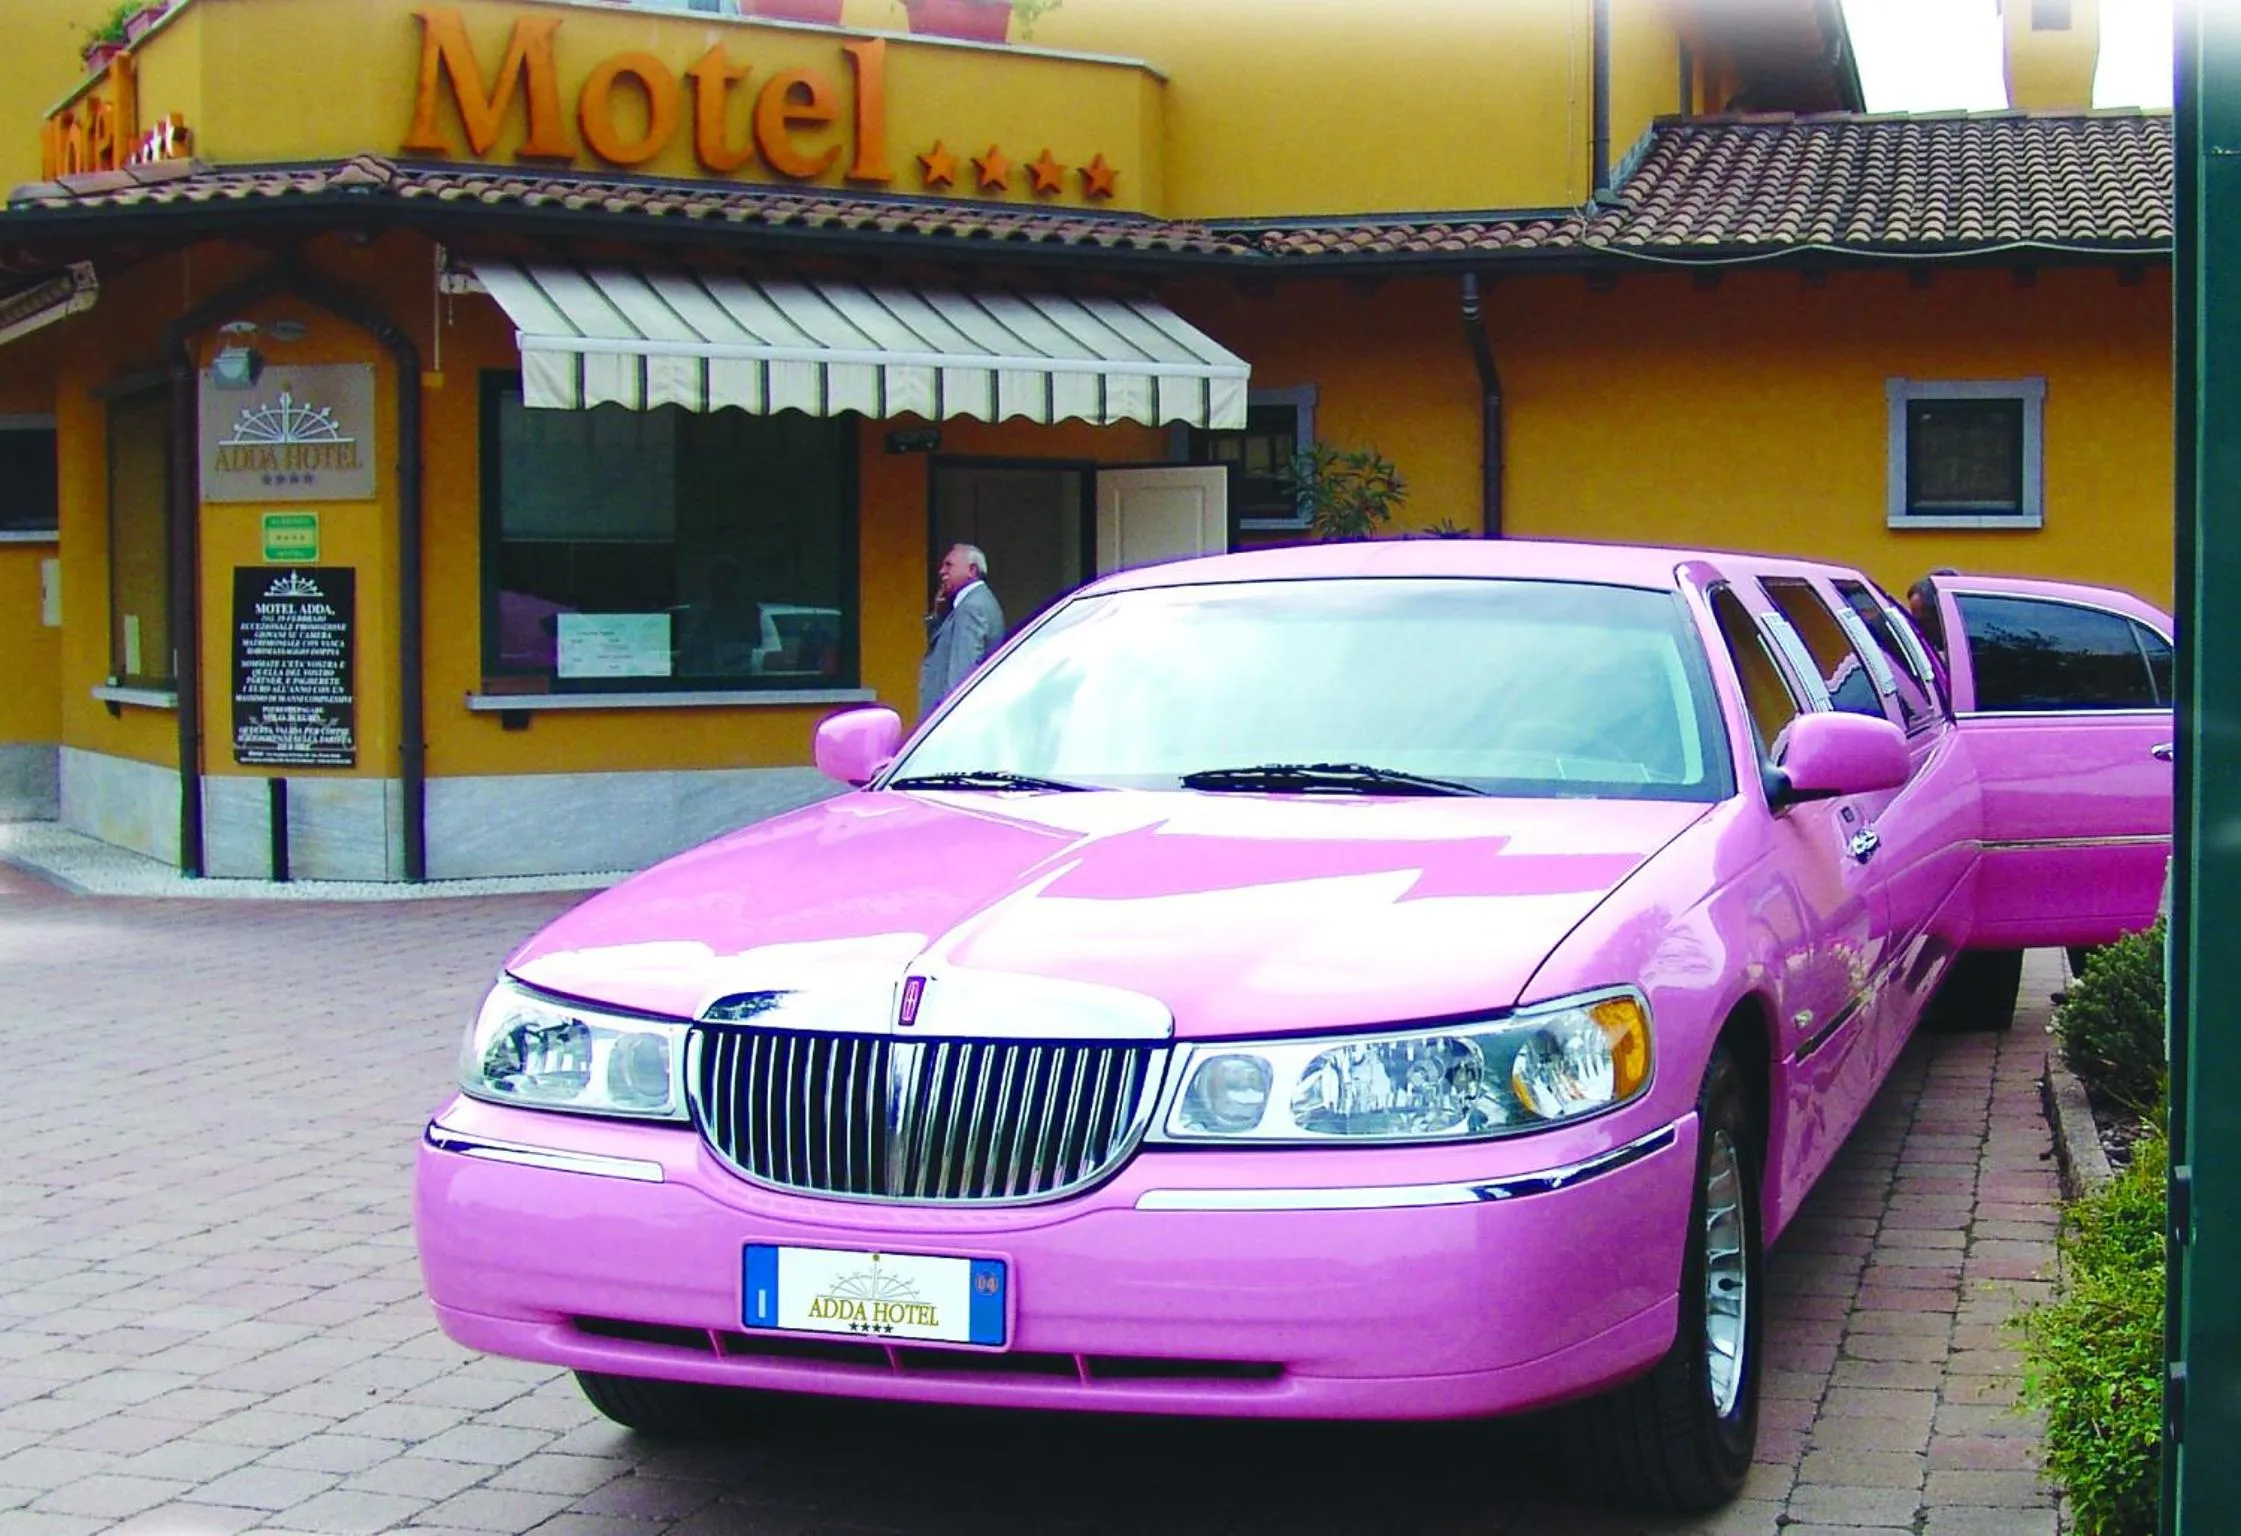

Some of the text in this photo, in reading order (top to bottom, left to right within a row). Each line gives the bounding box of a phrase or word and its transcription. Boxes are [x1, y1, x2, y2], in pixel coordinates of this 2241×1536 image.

[400, 9, 899, 184] Motel
[214, 442, 364, 472] ADDA HOTEL
[255, 603, 297, 615] MOTEL
[808, 1297, 939, 1326] ADDA HOTEL
